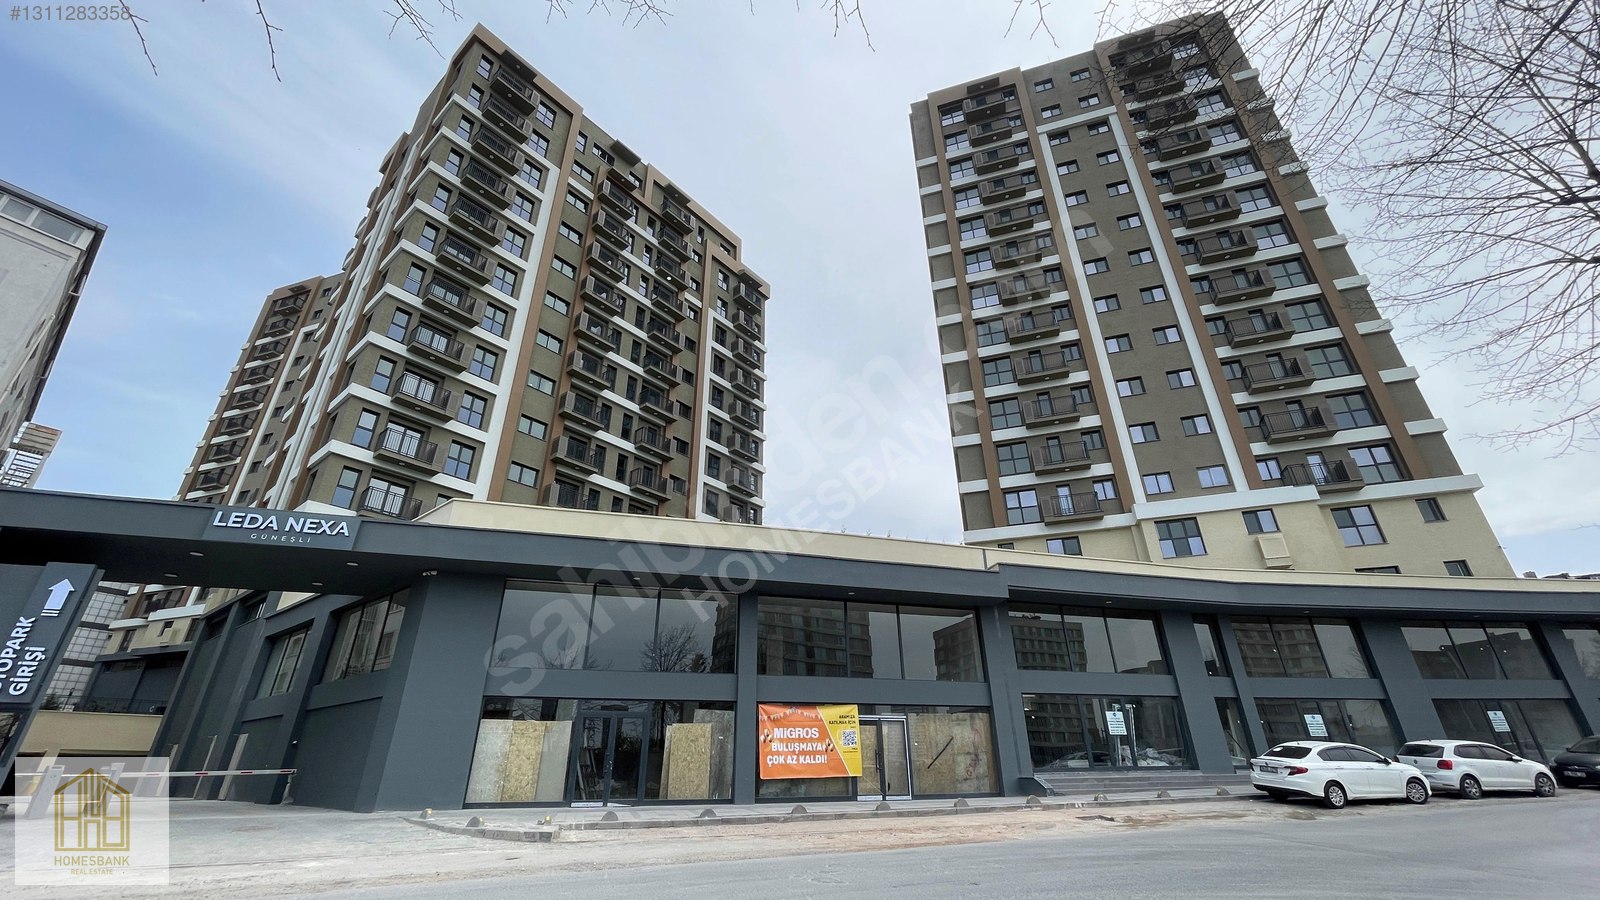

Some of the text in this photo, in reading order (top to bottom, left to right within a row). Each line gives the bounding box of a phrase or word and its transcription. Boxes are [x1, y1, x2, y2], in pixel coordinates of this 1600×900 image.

[212, 511, 350, 537] LEDA NEXA
[250, 533, 311, 543] GÜNEŞLİ
[0, 616, 36, 690] OPARK
[9, 646, 46, 696] GİRİŞİ
[771, 742, 824, 754] BULUŞMAYA
[766, 755, 828, 767] ÇOK AZ KALDI!
